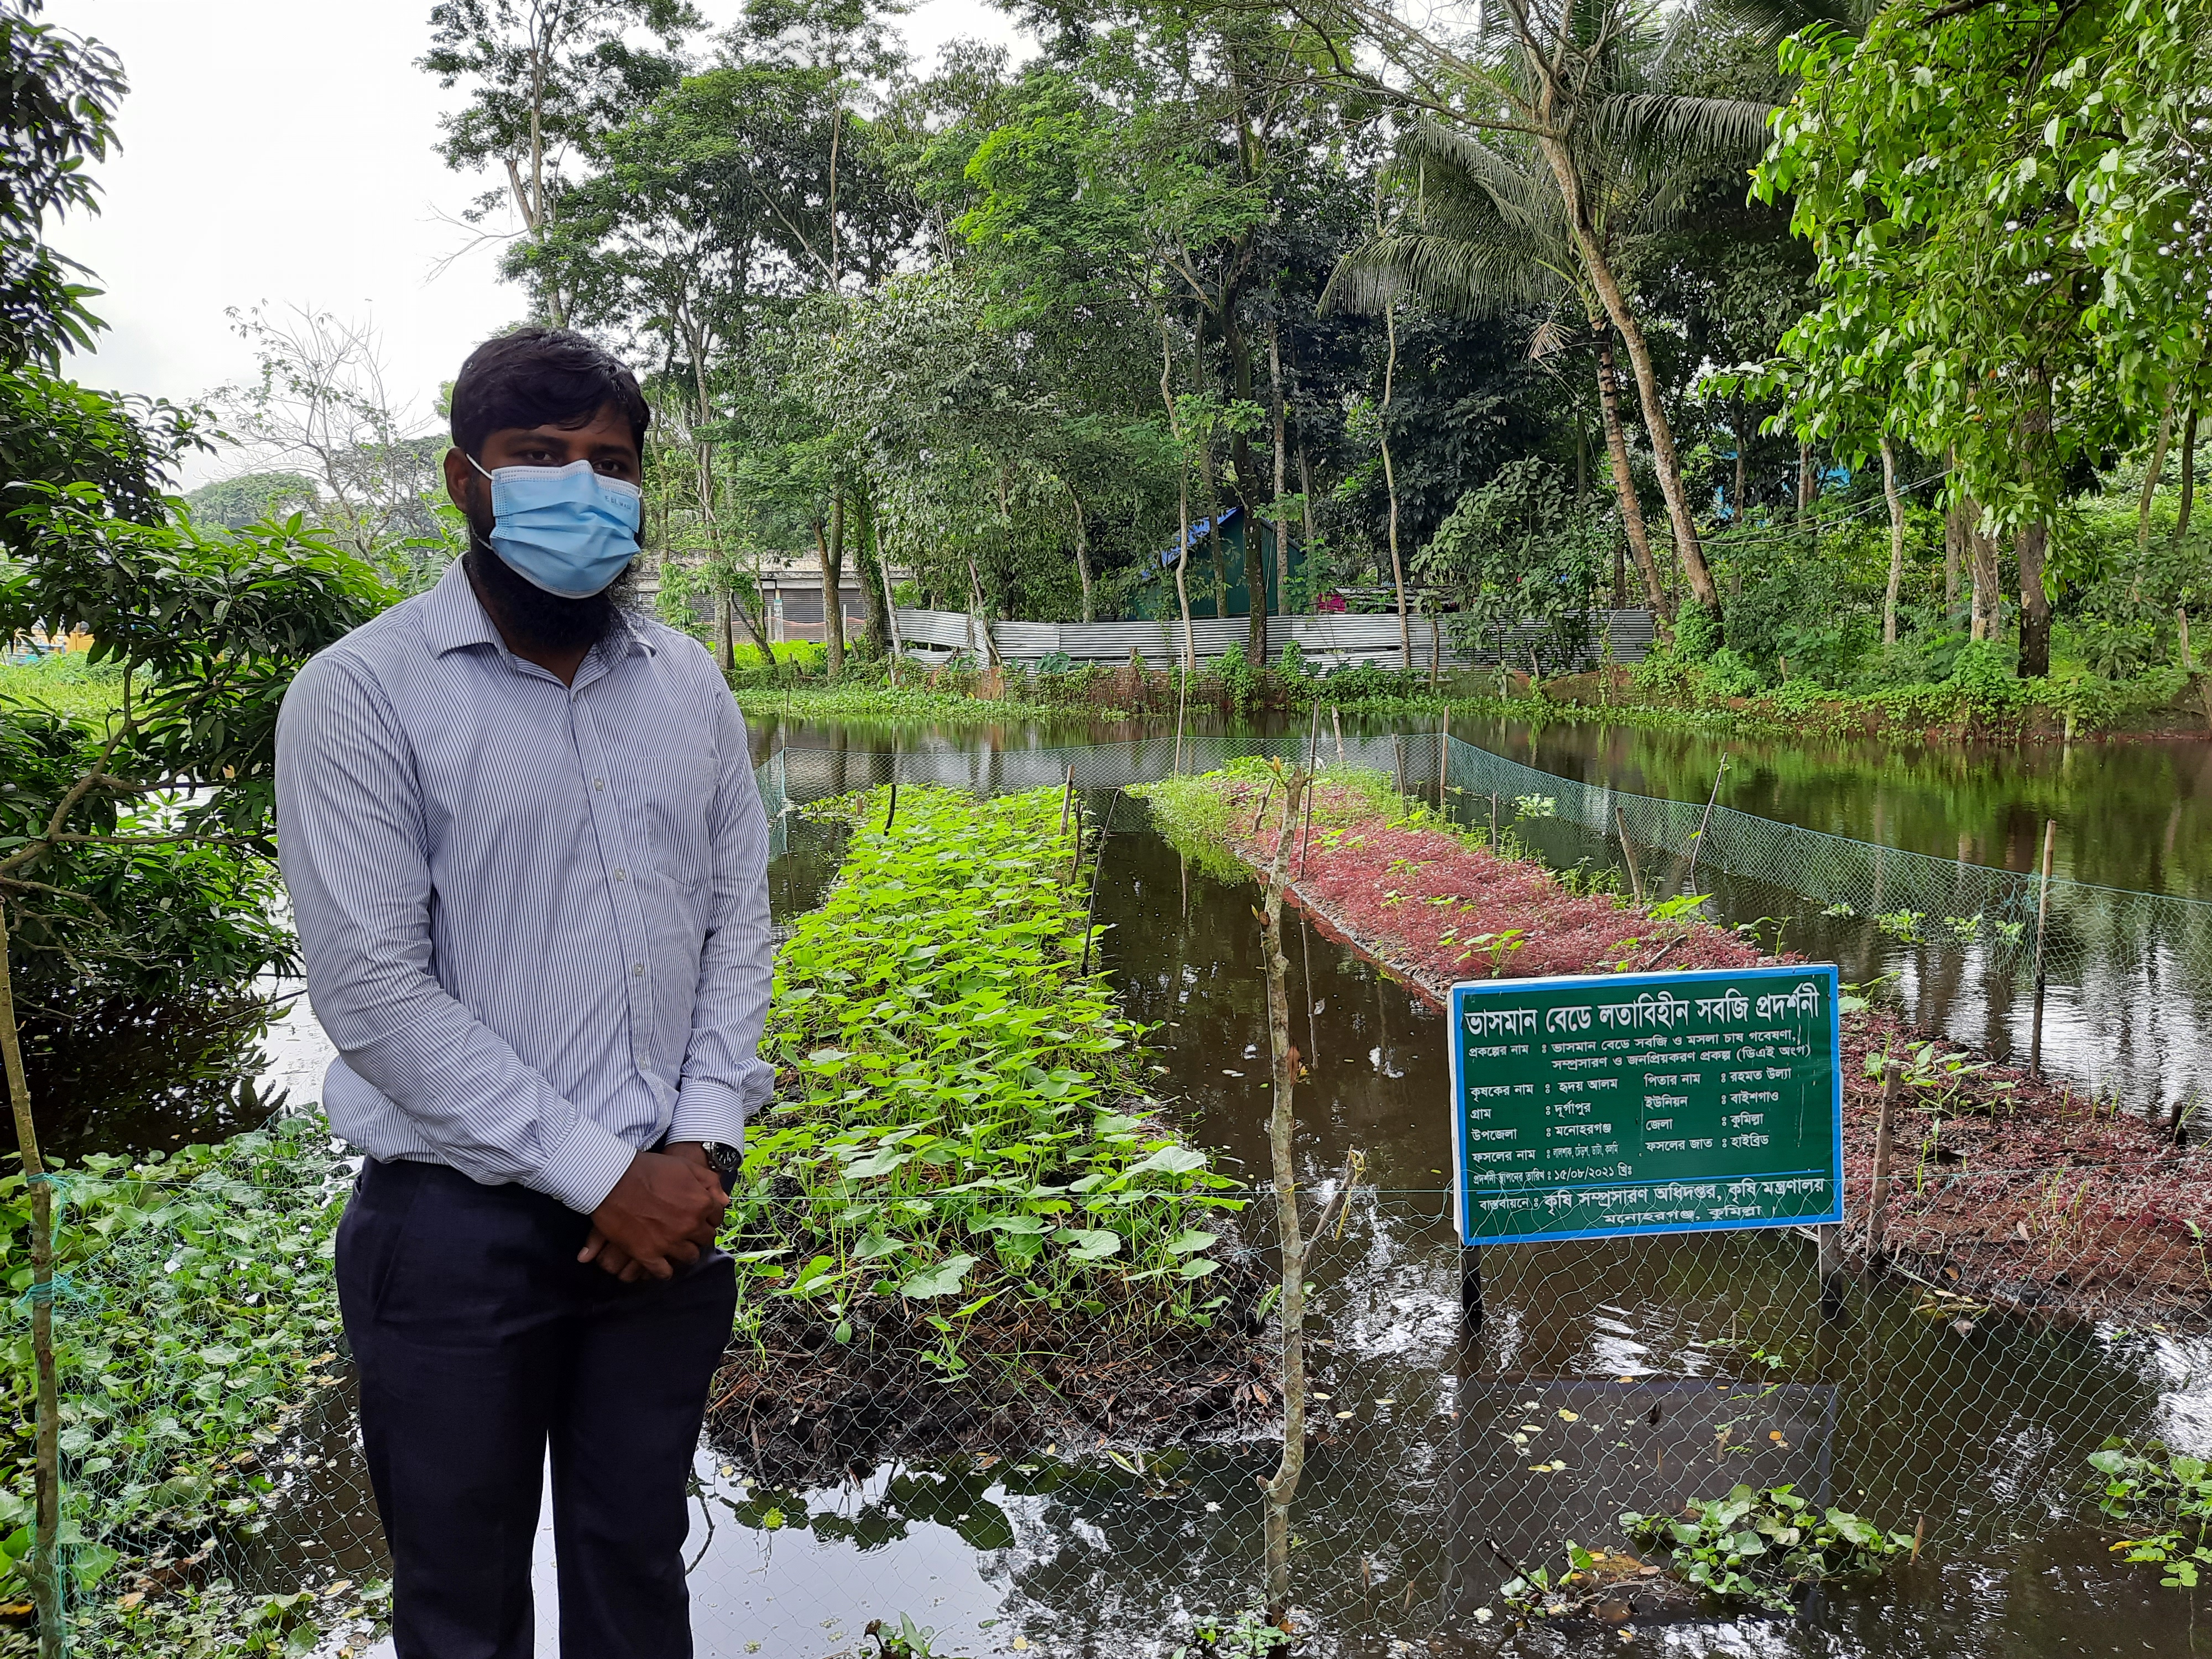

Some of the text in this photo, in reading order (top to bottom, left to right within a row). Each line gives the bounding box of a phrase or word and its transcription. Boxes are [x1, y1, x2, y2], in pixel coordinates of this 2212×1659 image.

[1464, 982, 1820, 1038] ভাসমান বেডে লতাবিহীন সবজি প্রদর্শনী
[1468, 1044, 1507, 1058] প্রকল্পের
[1510, 1044, 1529, 1055] নাম
[1551, 1041, 1597, 1053] ভাসমান
[1601, 1039, 1630, 1051] বেডে
[1634, 1034, 1668, 1049] সবজি
[1672, 1035, 1682, 1045] ও
[1687, 1033, 1719, 1045] মসলা
[1723, 1032, 1744, 1043] চাষ
[1749, 1029, 1796, 1042] গবেষণা,
[1552, 1056, 1608, 1071] সম্প্রসারণ
[1613, 1057, 1623, 1066] ও
[1626, 1051, 1696, 1066] জনপ্রিয়করণ
[1699, 1050, 1731, 1062] প্রকল্প
[1736, 1045, 1776, 1062] (ডিএই
[1644, 1073, 1677, 1087] পিতার
[1681, 1073, 1701, 1085] নাম
[1729, 1070, 1763, 1083] রহমত
[1766, 1067, 1792, 1080] উল্যা
[1469, 1086, 1510, 1102] কৃষকের
[1514, 1084, 1534, 1095] নাম
[1587, 1078, 1618, 1091] আলম
[1644, 1093, 1688, 1110] ইউনিয়ন
[1730, 1090, 1779, 1105] বাইশগাও
[1470, 1108, 1491, 1120] গ্রাম
[1554, 1100, 1591, 1118] দূর্গাপুর
[1646, 1118, 1673, 1131] জেলা
[1730, 1112, 1764, 1129] কুমিল্লা
[1470, 1128, 1517, 1141] উপজেলা
[1554, 1123, 1612, 1136] মনোহরগঞ্জ
[1645, 1140, 1686, 1152] ফসলের
[1689, 1138, 1713, 1150] জাত
[1730, 1133, 1770, 1147] হাইব্রিড
[1472, 1150, 1512, 1163] ফসলের
[1515, 1149, 1536, 1161] নাম
[1525, 1167, 1545, 1182] তারিখ
[1554, 1166, 1615, 1181] ১৫/০৮/২০২১
[1478, 1198, 1529, 1211] বাস্তবায়নে
[1543, 1189, 1573, 1216] কৃষি
[1578, 1188, 1649, 1207] সম্প্রসারণ
[1653, 1182, 1722, 1202] অধিদপ্তর,
[1726, 1178, 1758, 1204] কৃষি
[1762, 1178, 1825, 1196] মন্ত্রণালয়
[1707, 1205, 1762, 1220] কুমিল্লা
